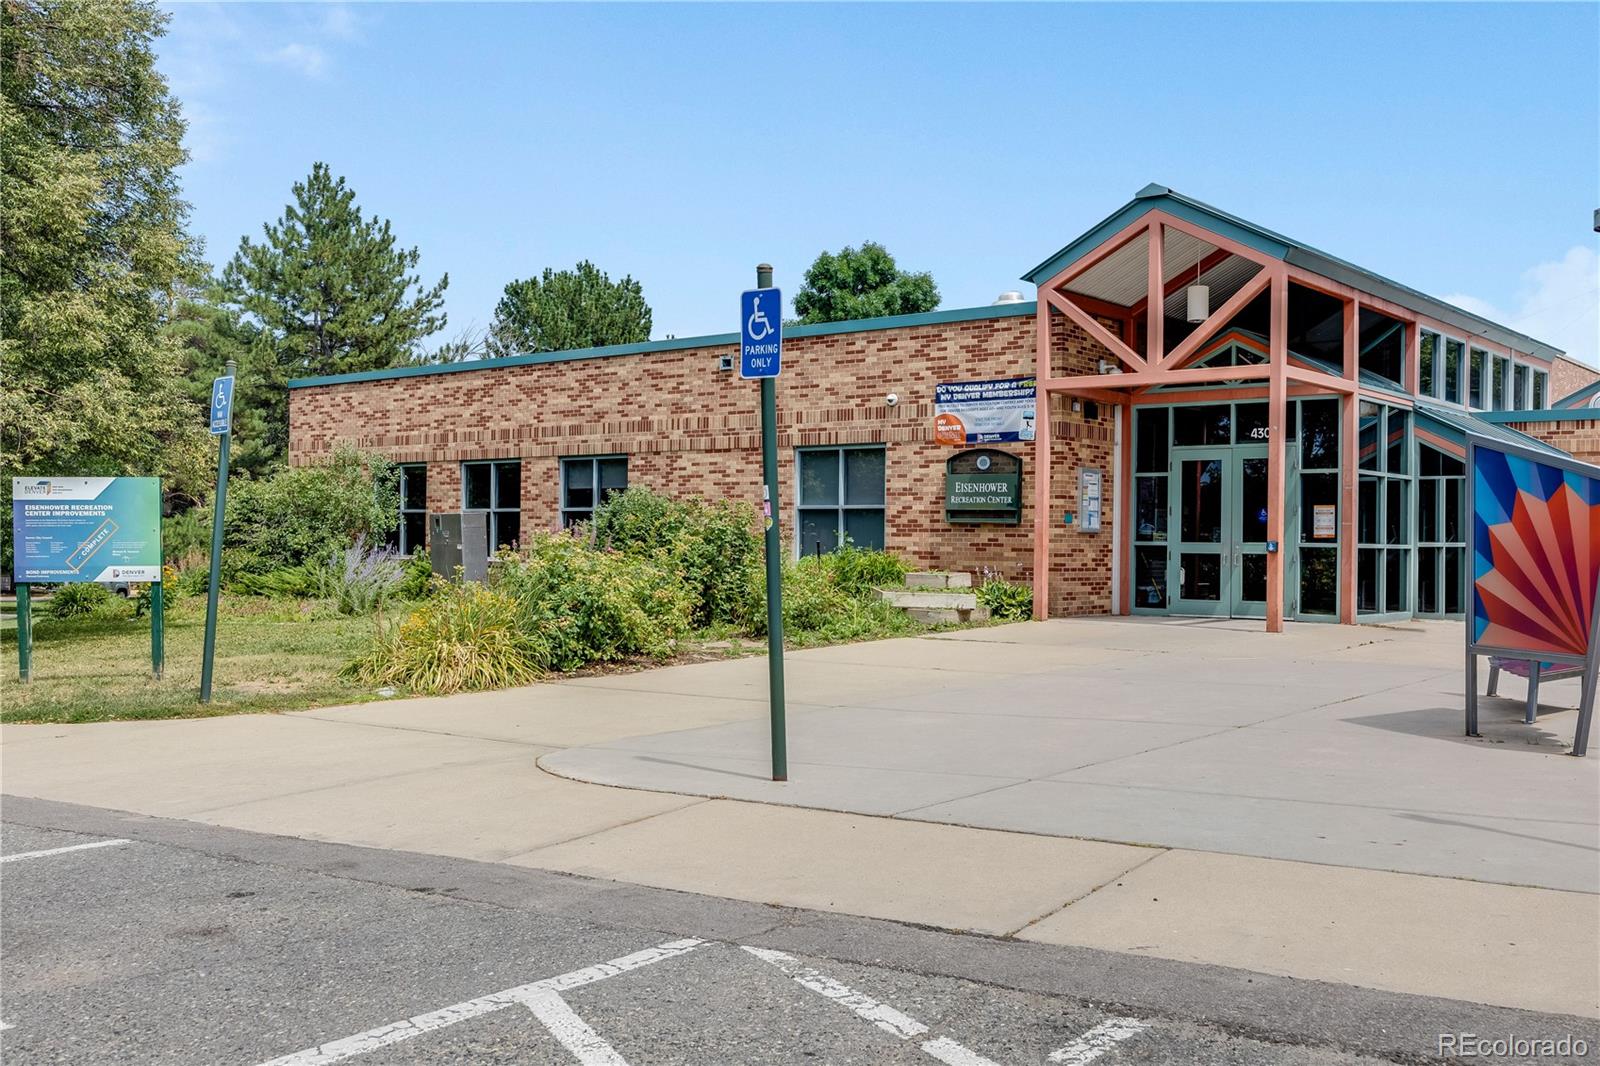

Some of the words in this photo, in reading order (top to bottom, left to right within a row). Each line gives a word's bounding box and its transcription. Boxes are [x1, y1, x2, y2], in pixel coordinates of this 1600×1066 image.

[745, 344, 778, 355] PARKING
[751, 357, 772, 368] ONLY
[964, 383, 993, 391] QUALIFY
[994, 382, 1010, 390] FOR
[953, 392, 980, 400] DENVER
[982, 388, 1034, 398] MEMBERSHIP?
[1251, 427, 1269, 438] 430
[955, 482, 1008, 493] EISENHOWER
[81, 528, 110, 556] COMPLETE
